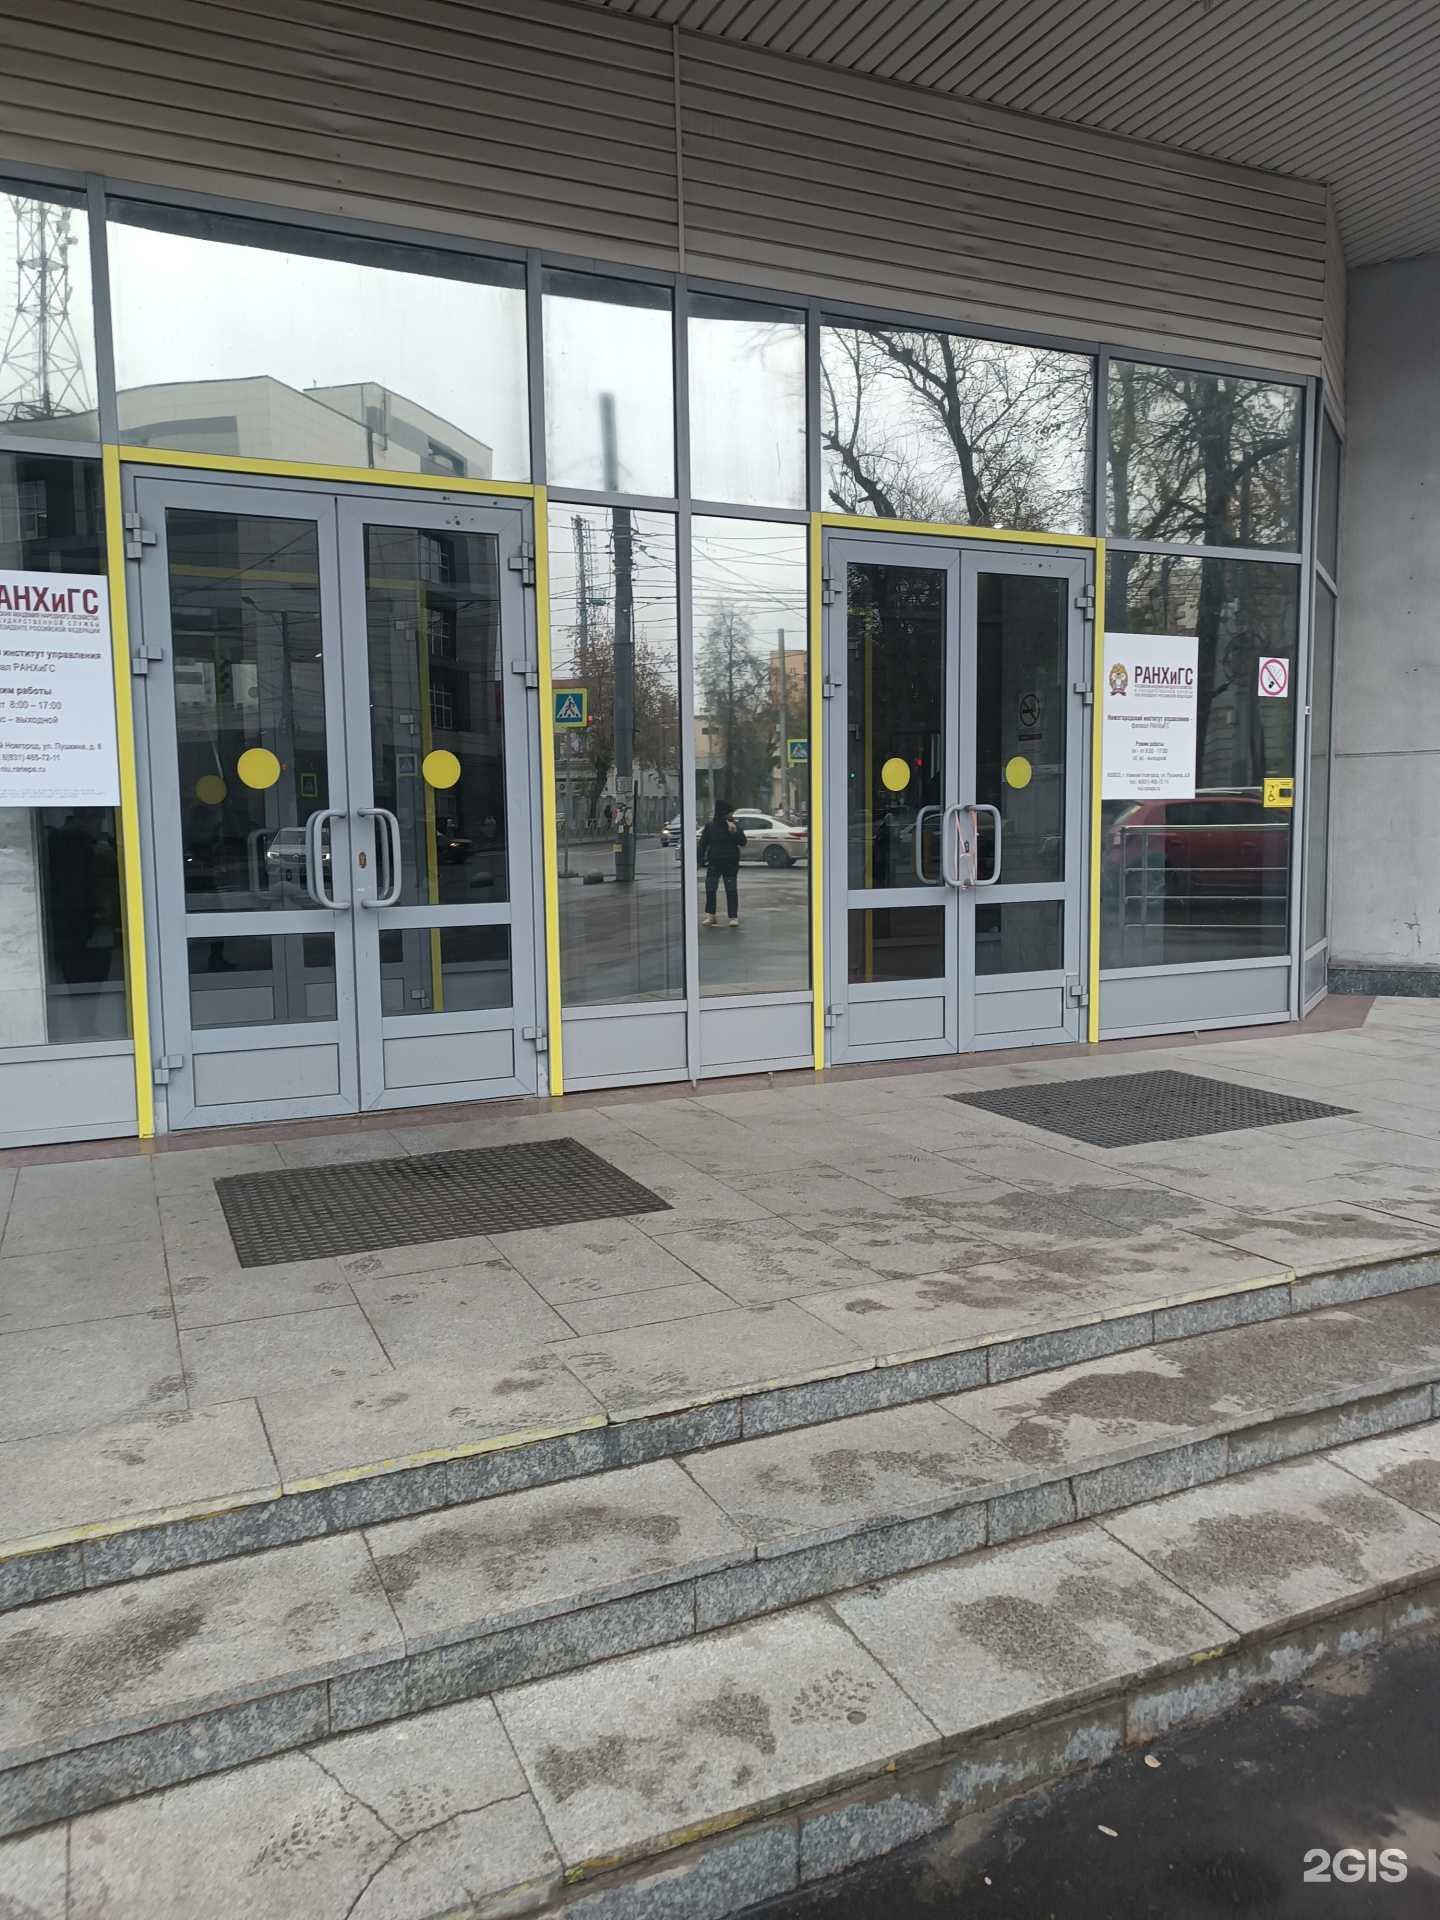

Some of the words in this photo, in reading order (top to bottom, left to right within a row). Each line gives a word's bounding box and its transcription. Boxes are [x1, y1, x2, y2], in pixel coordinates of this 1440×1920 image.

[0, 584, 99, 614] АНХиГС
[3, 651, 45, 660] институт
[46, 652, 102, 660] управления
[13, 663, 56, 673] РАНХиГС
[1134, 666, 1194, 685] РАНХиГС
[16, 687, 52, 697] работы
